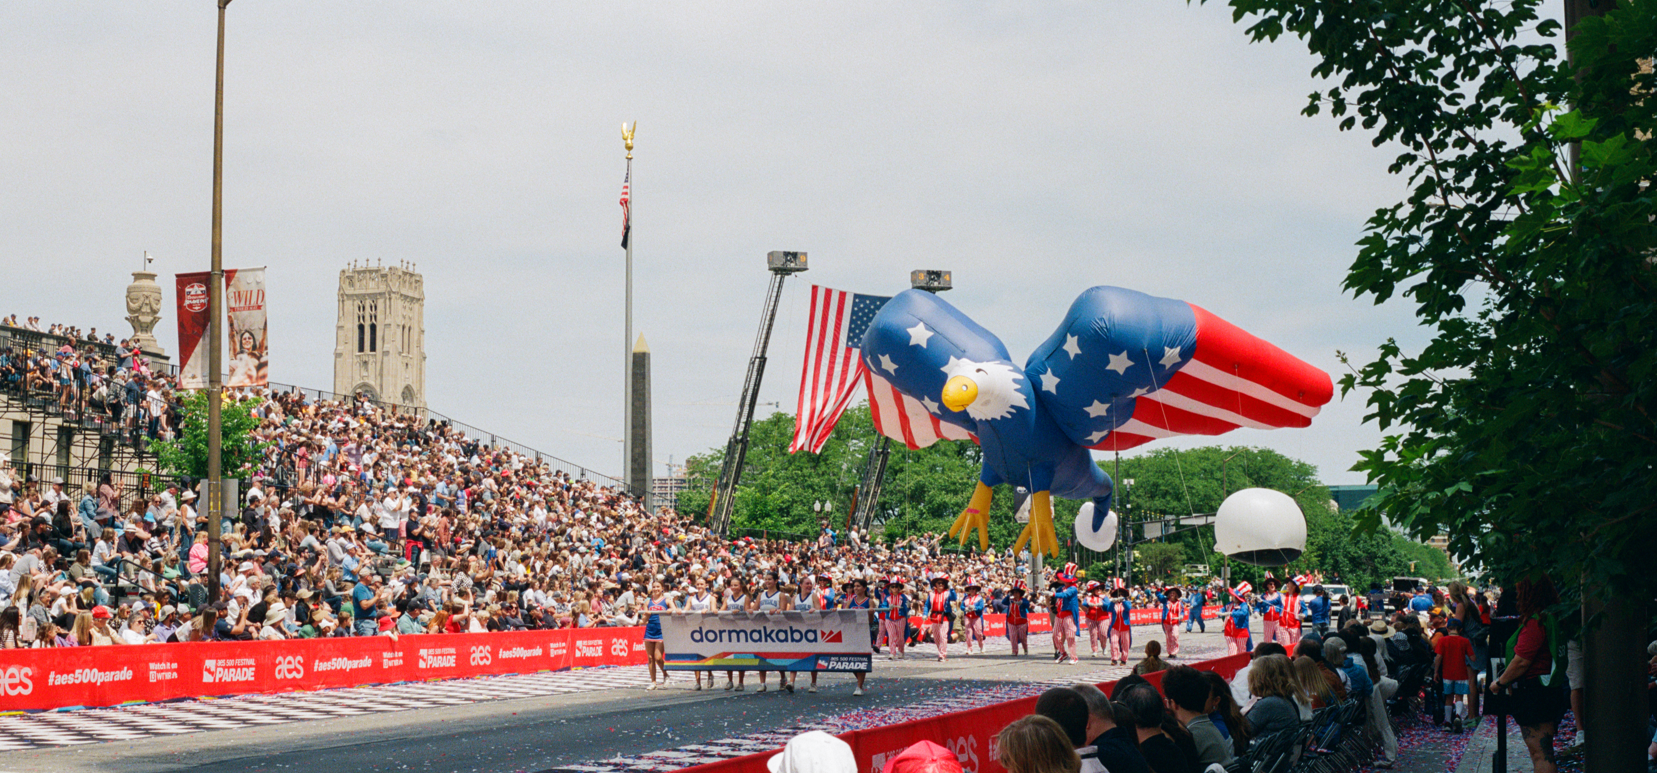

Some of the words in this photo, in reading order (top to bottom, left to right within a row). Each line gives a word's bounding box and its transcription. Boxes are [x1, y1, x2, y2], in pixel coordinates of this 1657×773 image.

[943, 273, 950, 281] 4
[227, 289, 265, 306] WILD
[690, 626, 818, 643] dormakaba
[470, 645, 491, 666] aes
[499, 646, 542, 660] #aes500parade
[611, 638, 628, 656] aes
[275, 656, 304, 680] aes
[314, 656, 372, 672] #aes500parade
[427, 656, 456, 668] PARADE
[48, 666, 132, 686] #aes500parade
[216, 667, 255, 682] PARADE
